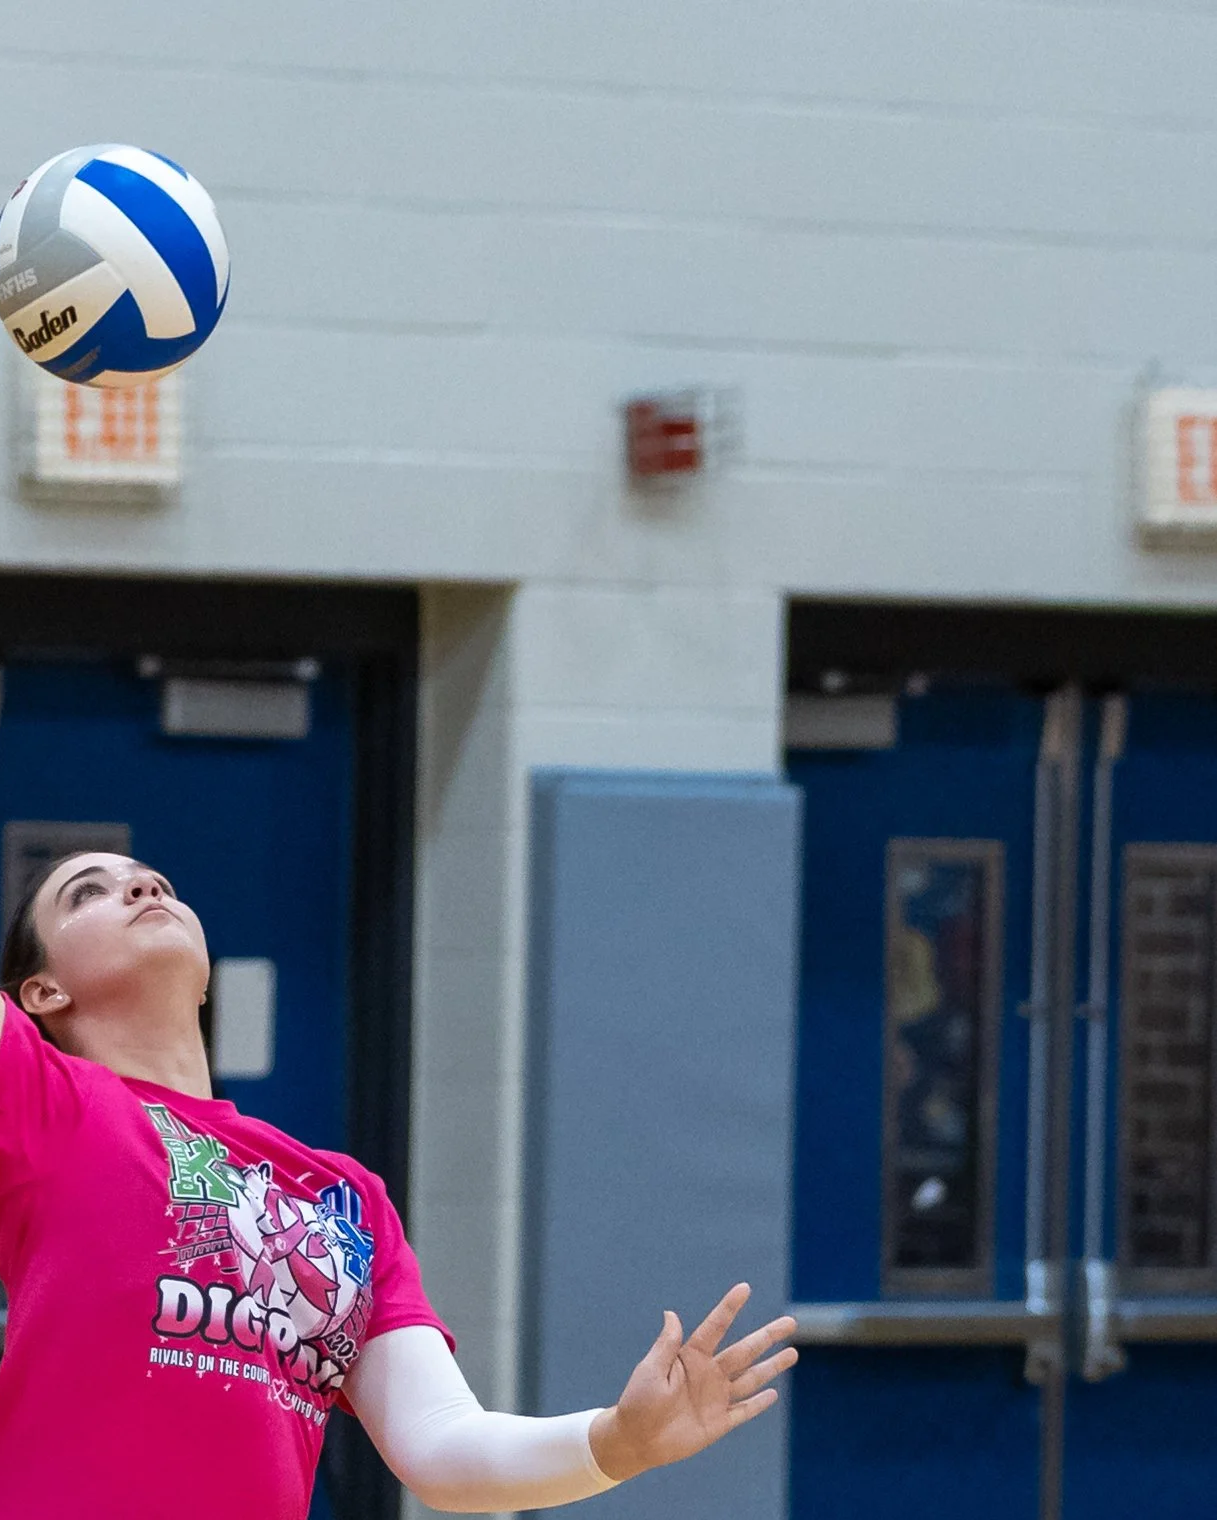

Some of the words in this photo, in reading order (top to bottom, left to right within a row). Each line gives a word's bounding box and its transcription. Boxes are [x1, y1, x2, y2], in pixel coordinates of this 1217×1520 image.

[170, 1141, 194, 1190] CAPTAINS
[155, 1278, 265, 1351] DIG
[149, 1347, 194, 1368] RIVALS
[198, 1354, 215, 1371] ON
[219, 1358, 240, 1376] THE
